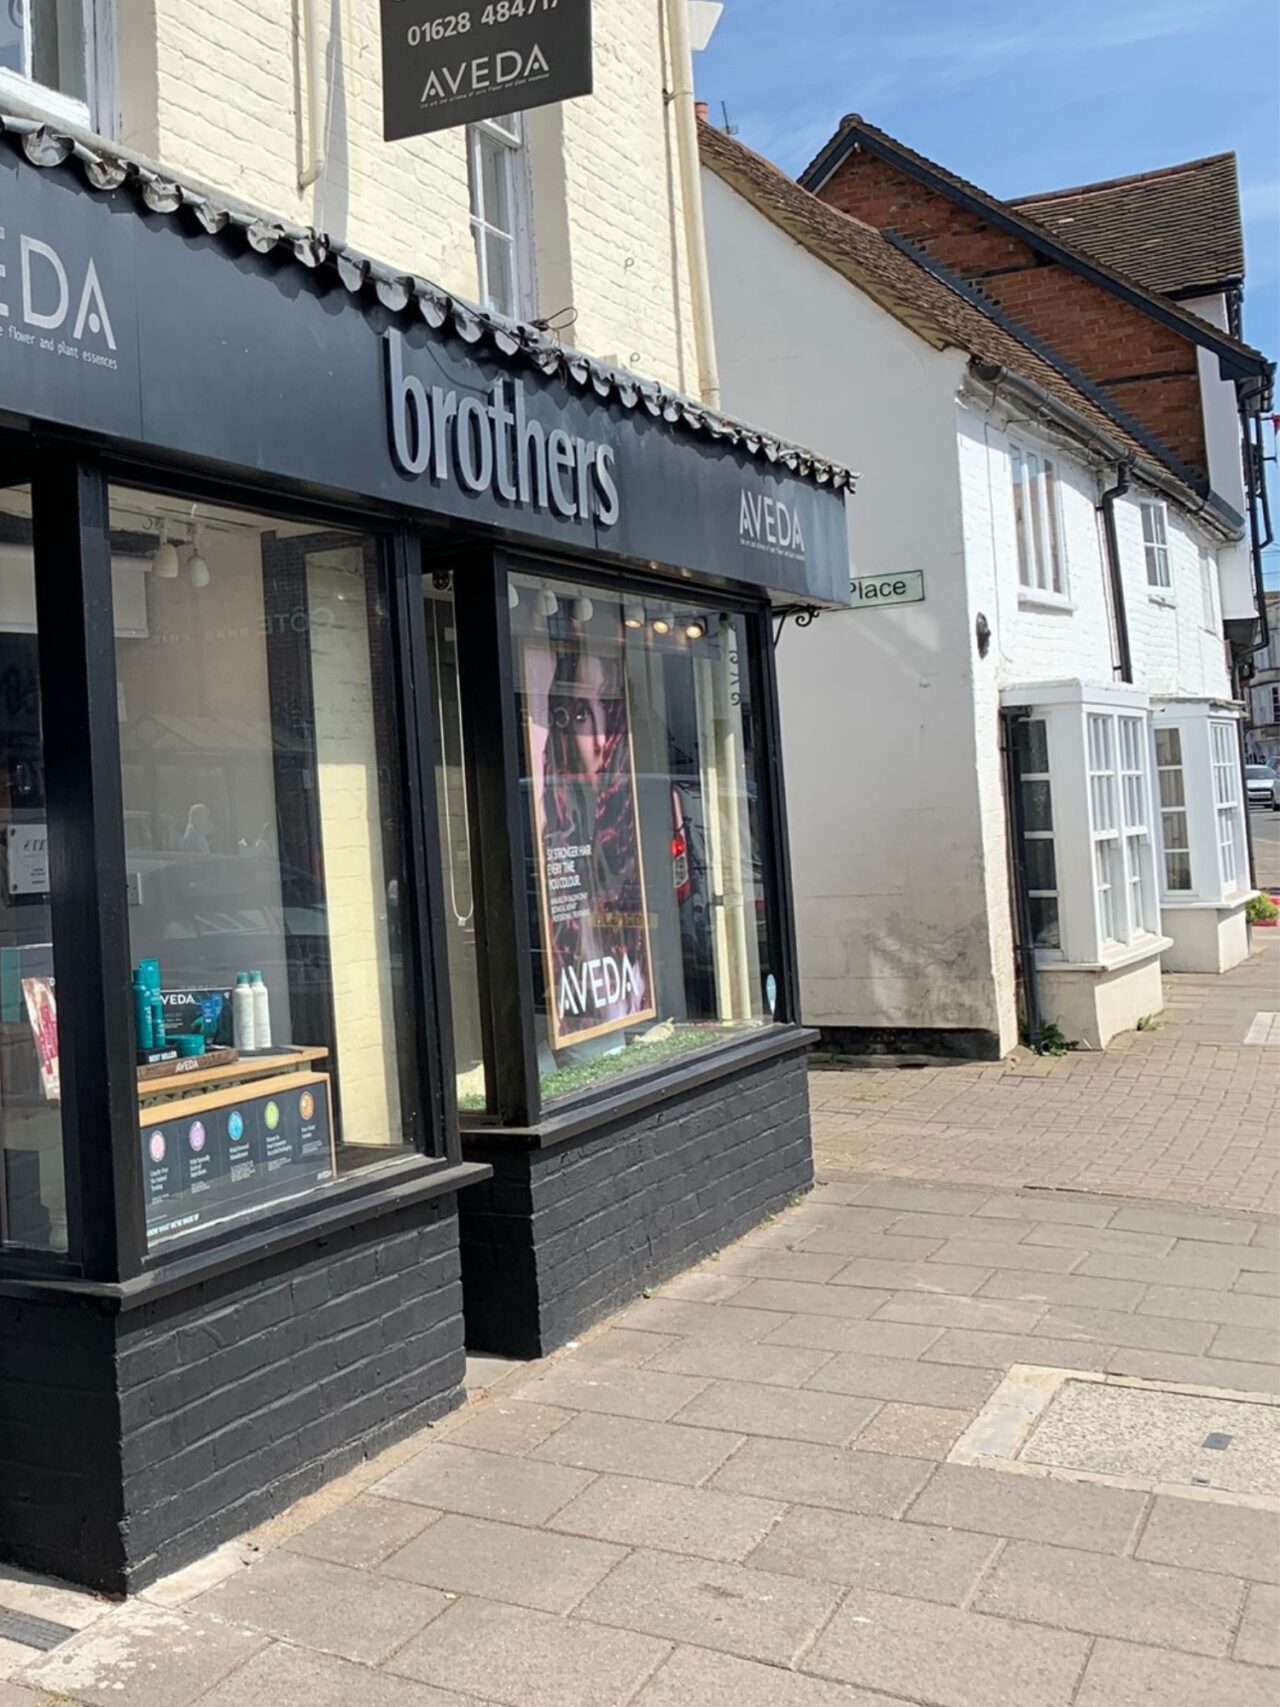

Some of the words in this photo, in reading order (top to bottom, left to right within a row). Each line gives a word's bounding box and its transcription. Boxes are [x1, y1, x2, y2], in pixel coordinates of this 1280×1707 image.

[407, 11, 471, 46] 01628
[420, 43, 550, 103] AVEDA
[8, 324, 36, 346] flower
[39, 336, 55, 352] and
[57, 341, 79, 360] plant
[82, 351, 118, 370] essences
[386, 326, 620, 527] brothers
[739, 487, 806, 552] AVEDA
[159, 993, 196, 1006] VEDA
[559, 952, 640, 1019] AVEDA
[175, 1060, 199, 1073] AVEDA
